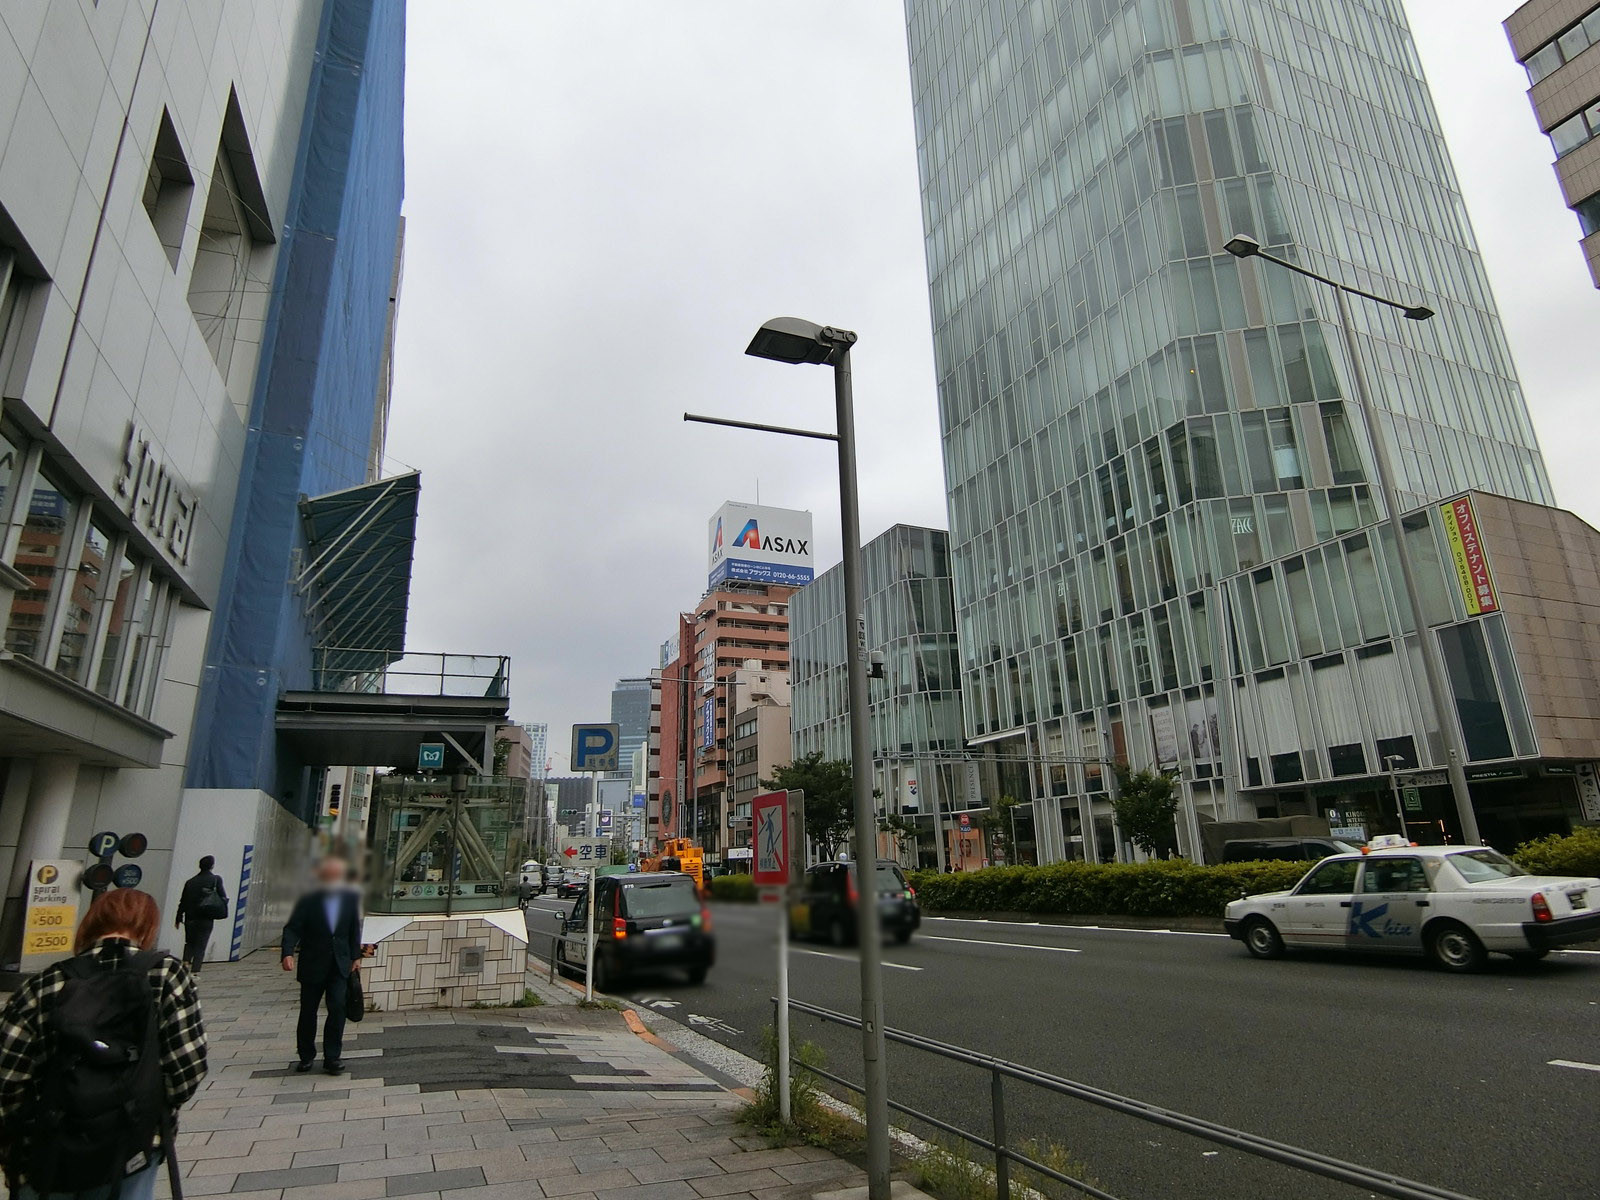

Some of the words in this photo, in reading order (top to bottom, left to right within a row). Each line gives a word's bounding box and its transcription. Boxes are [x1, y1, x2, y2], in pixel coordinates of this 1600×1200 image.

[762, 535, 809, 556] ASAX
[1456, 503, 1493, 607] オフィステナント募集
[576, 728, 614, 768] P
[99, 834, 116, 856] P
[579, 845, 608, 861] 空車
[33, 895, 67, 903] Parking
[34, 885, 60, 894] spiral
